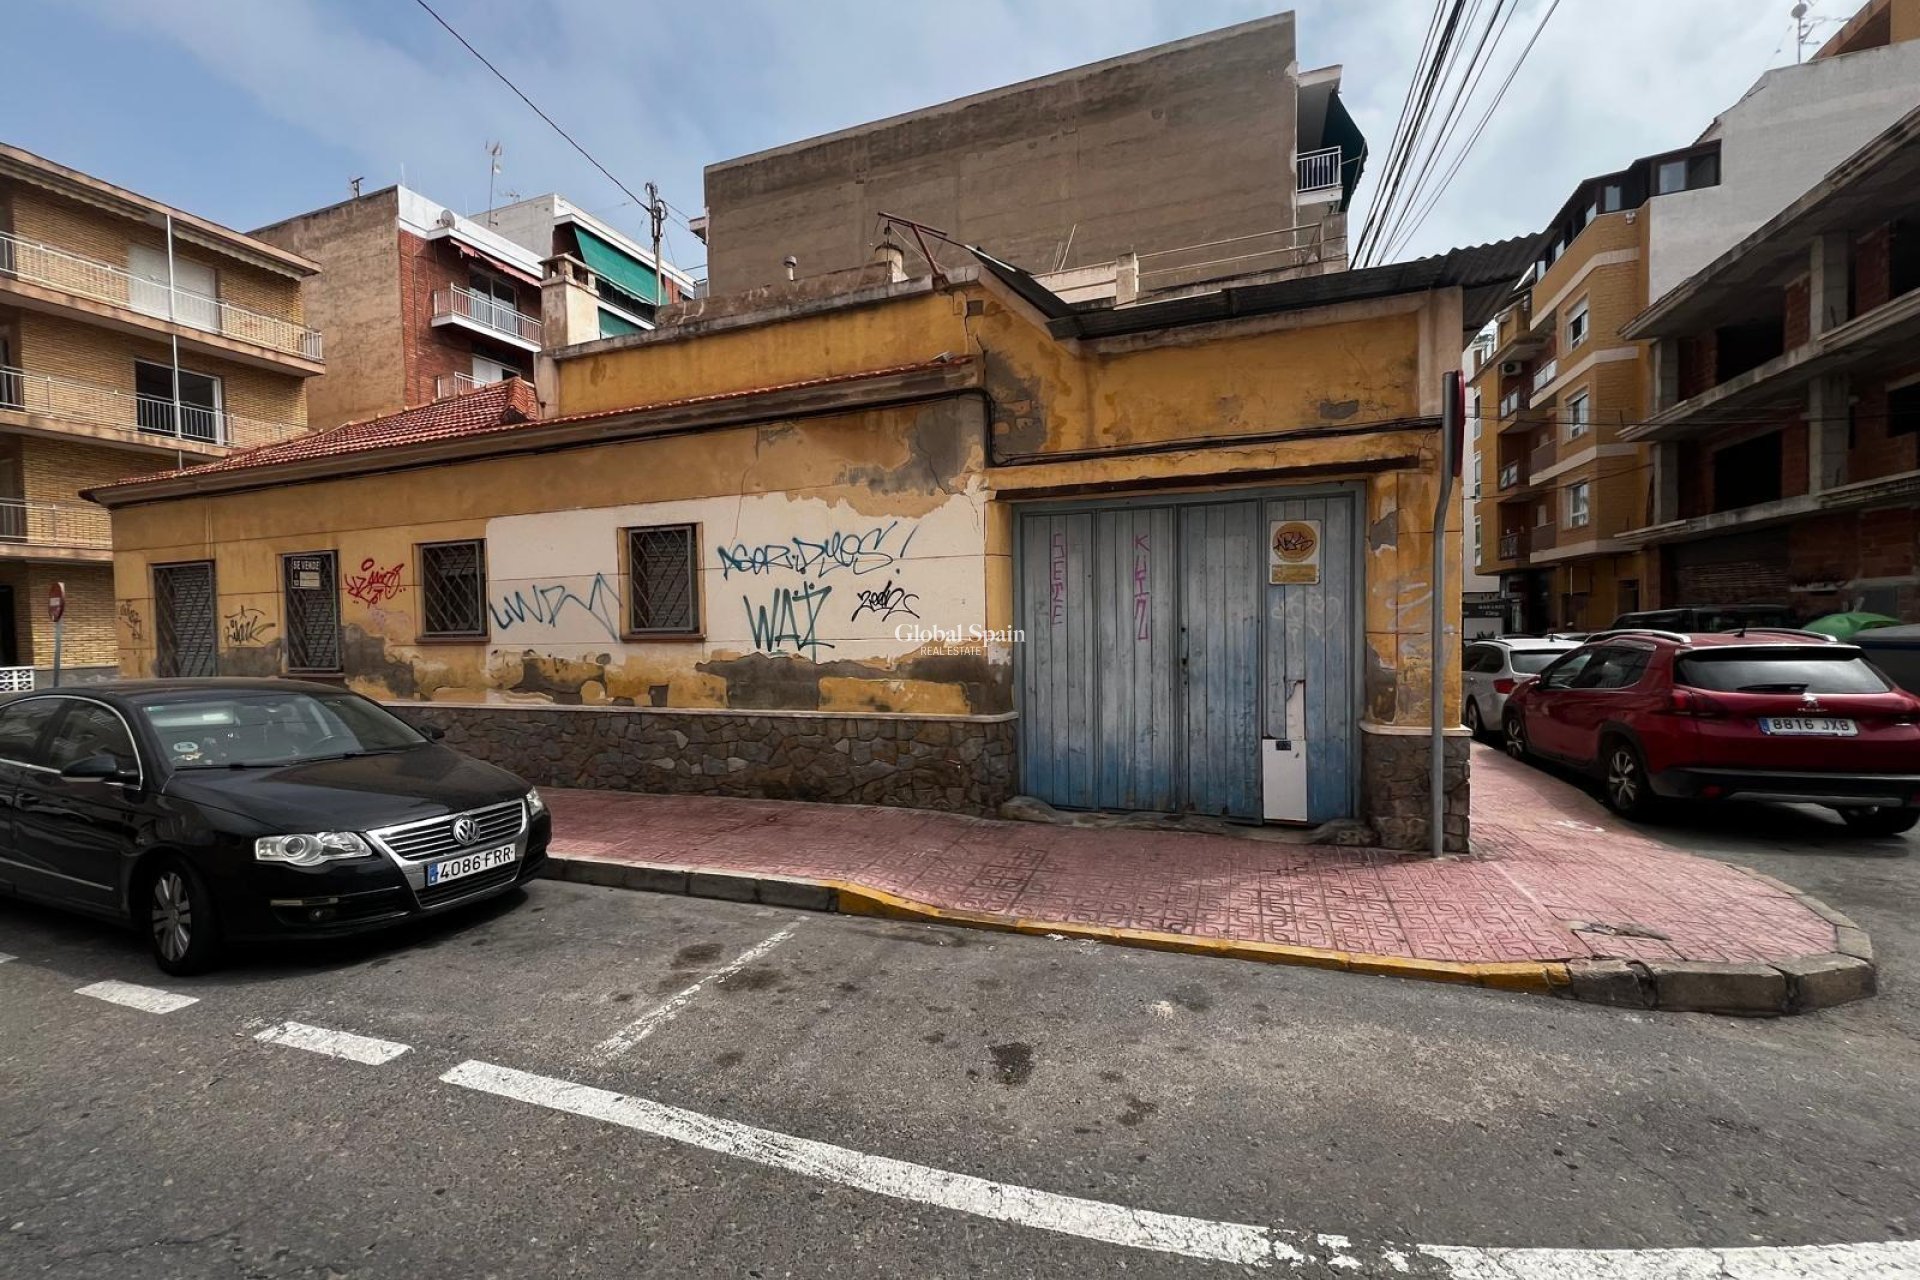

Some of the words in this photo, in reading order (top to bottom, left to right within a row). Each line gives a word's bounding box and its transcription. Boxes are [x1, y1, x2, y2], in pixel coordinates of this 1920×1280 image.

[1772, 718, 1814, 730] 8816
[1822, 719, 1850, 731] JXB
[440, 855, 481, 879] 4086
[485, 846, 511, 867] FRR
